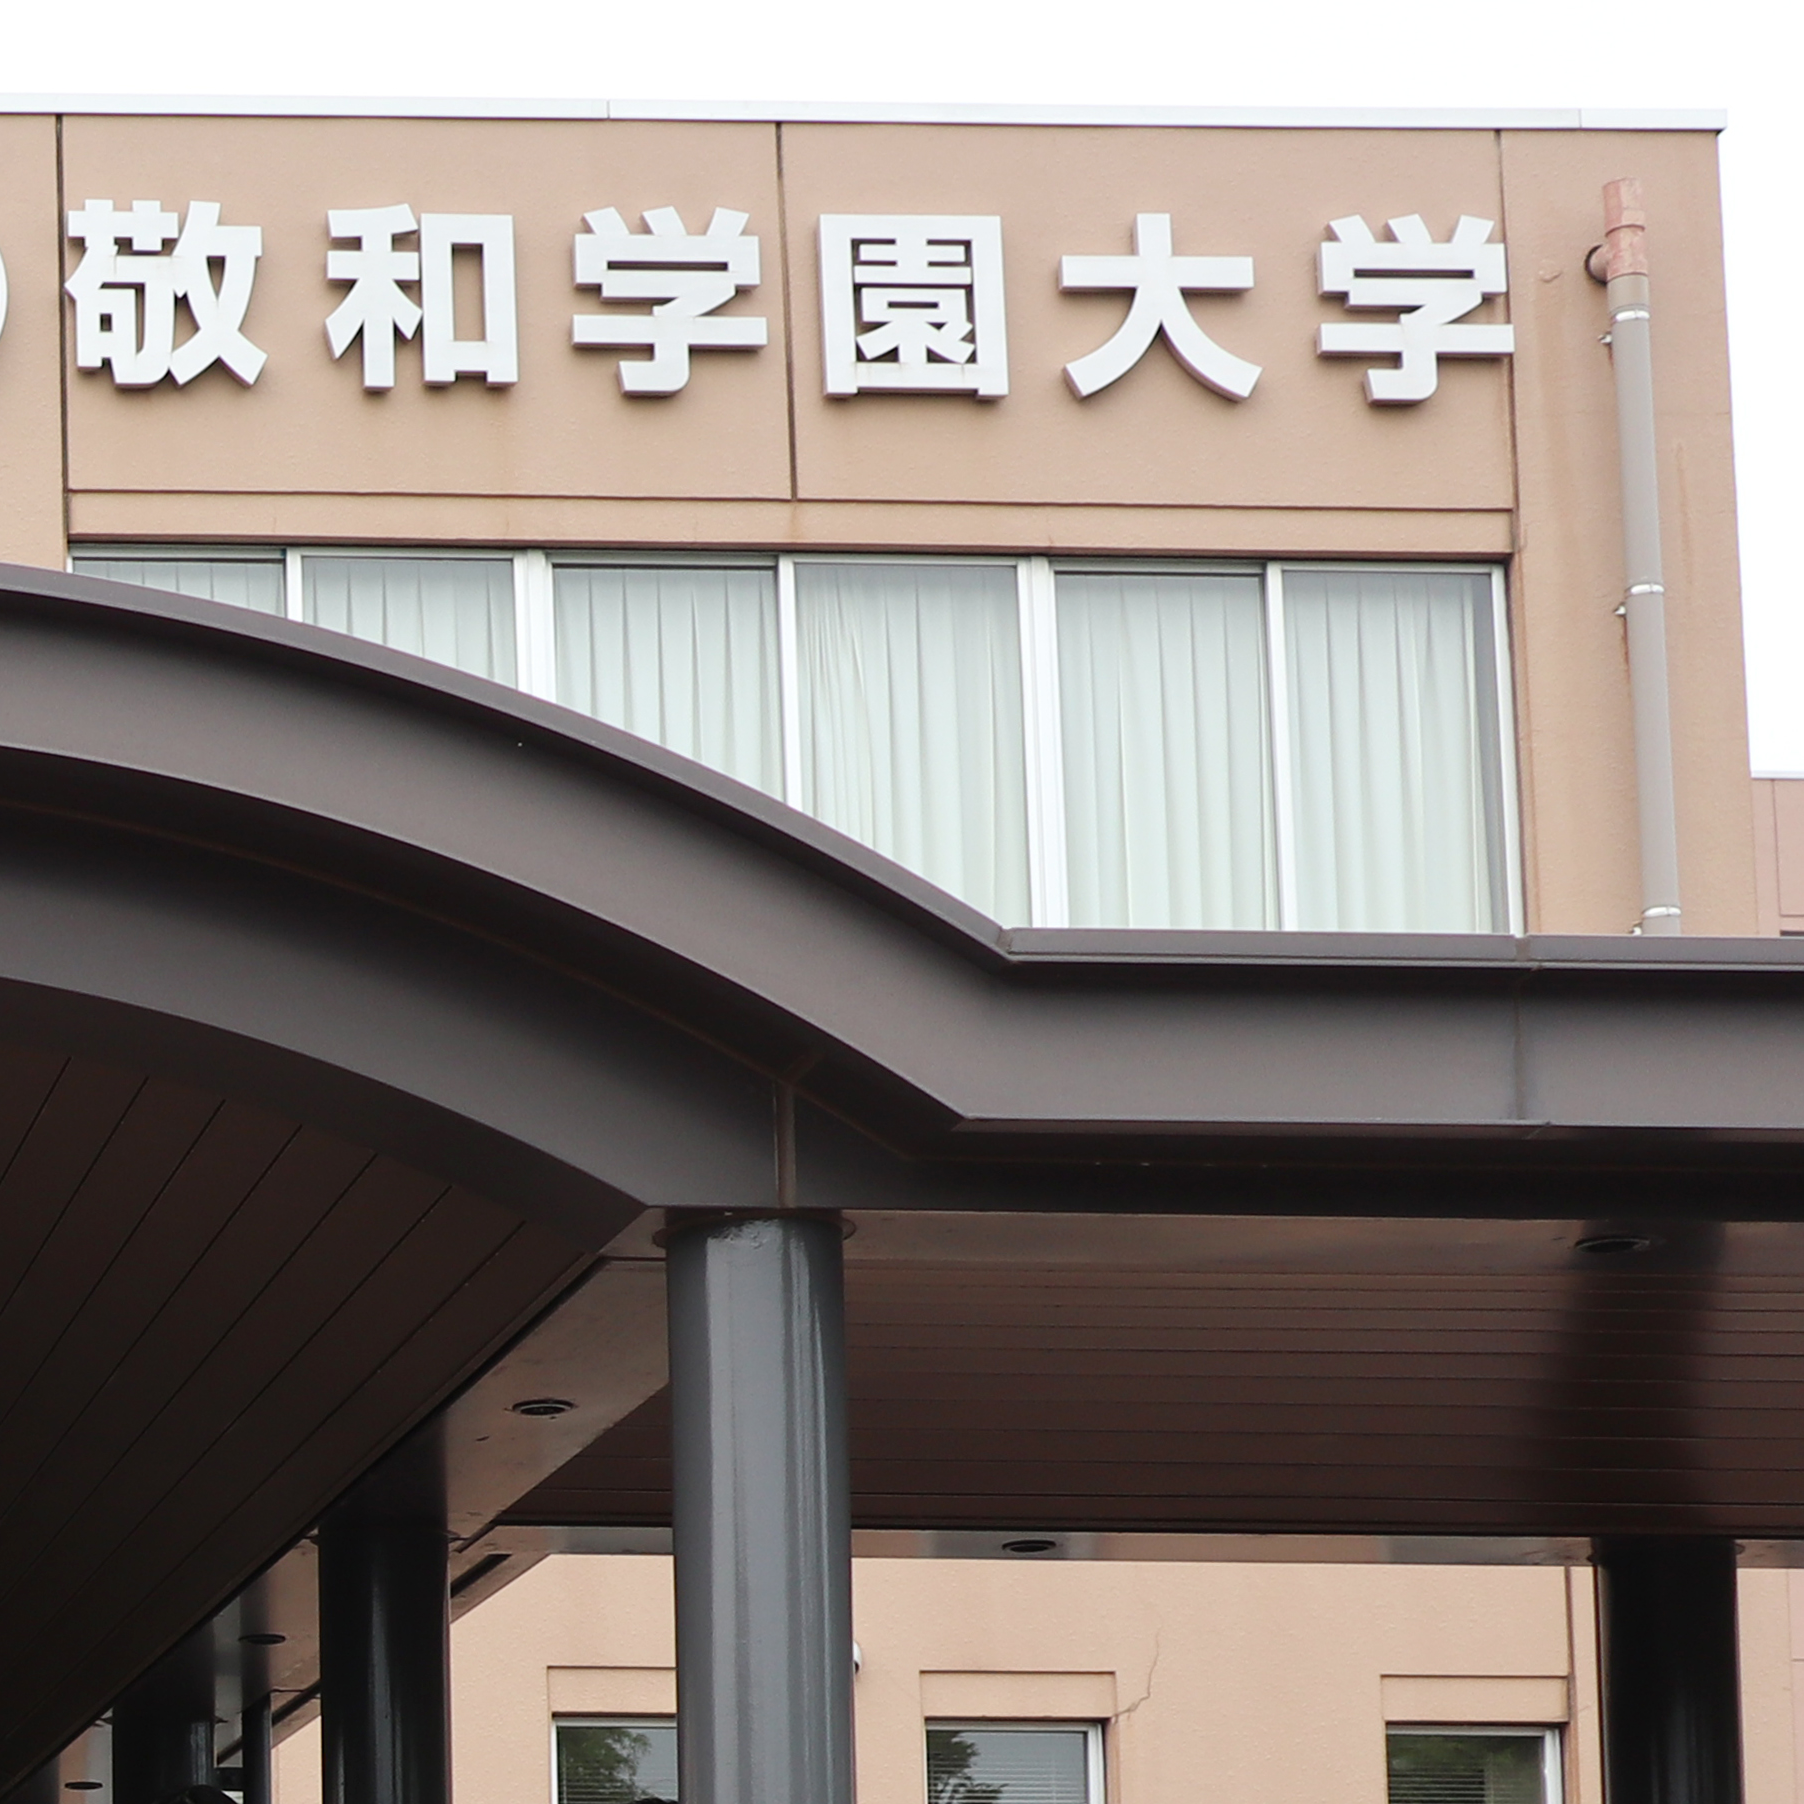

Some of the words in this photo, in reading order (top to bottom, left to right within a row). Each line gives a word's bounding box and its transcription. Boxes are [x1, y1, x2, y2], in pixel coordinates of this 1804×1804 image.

[63, 198, 1515, 403] 敬和学園大学
